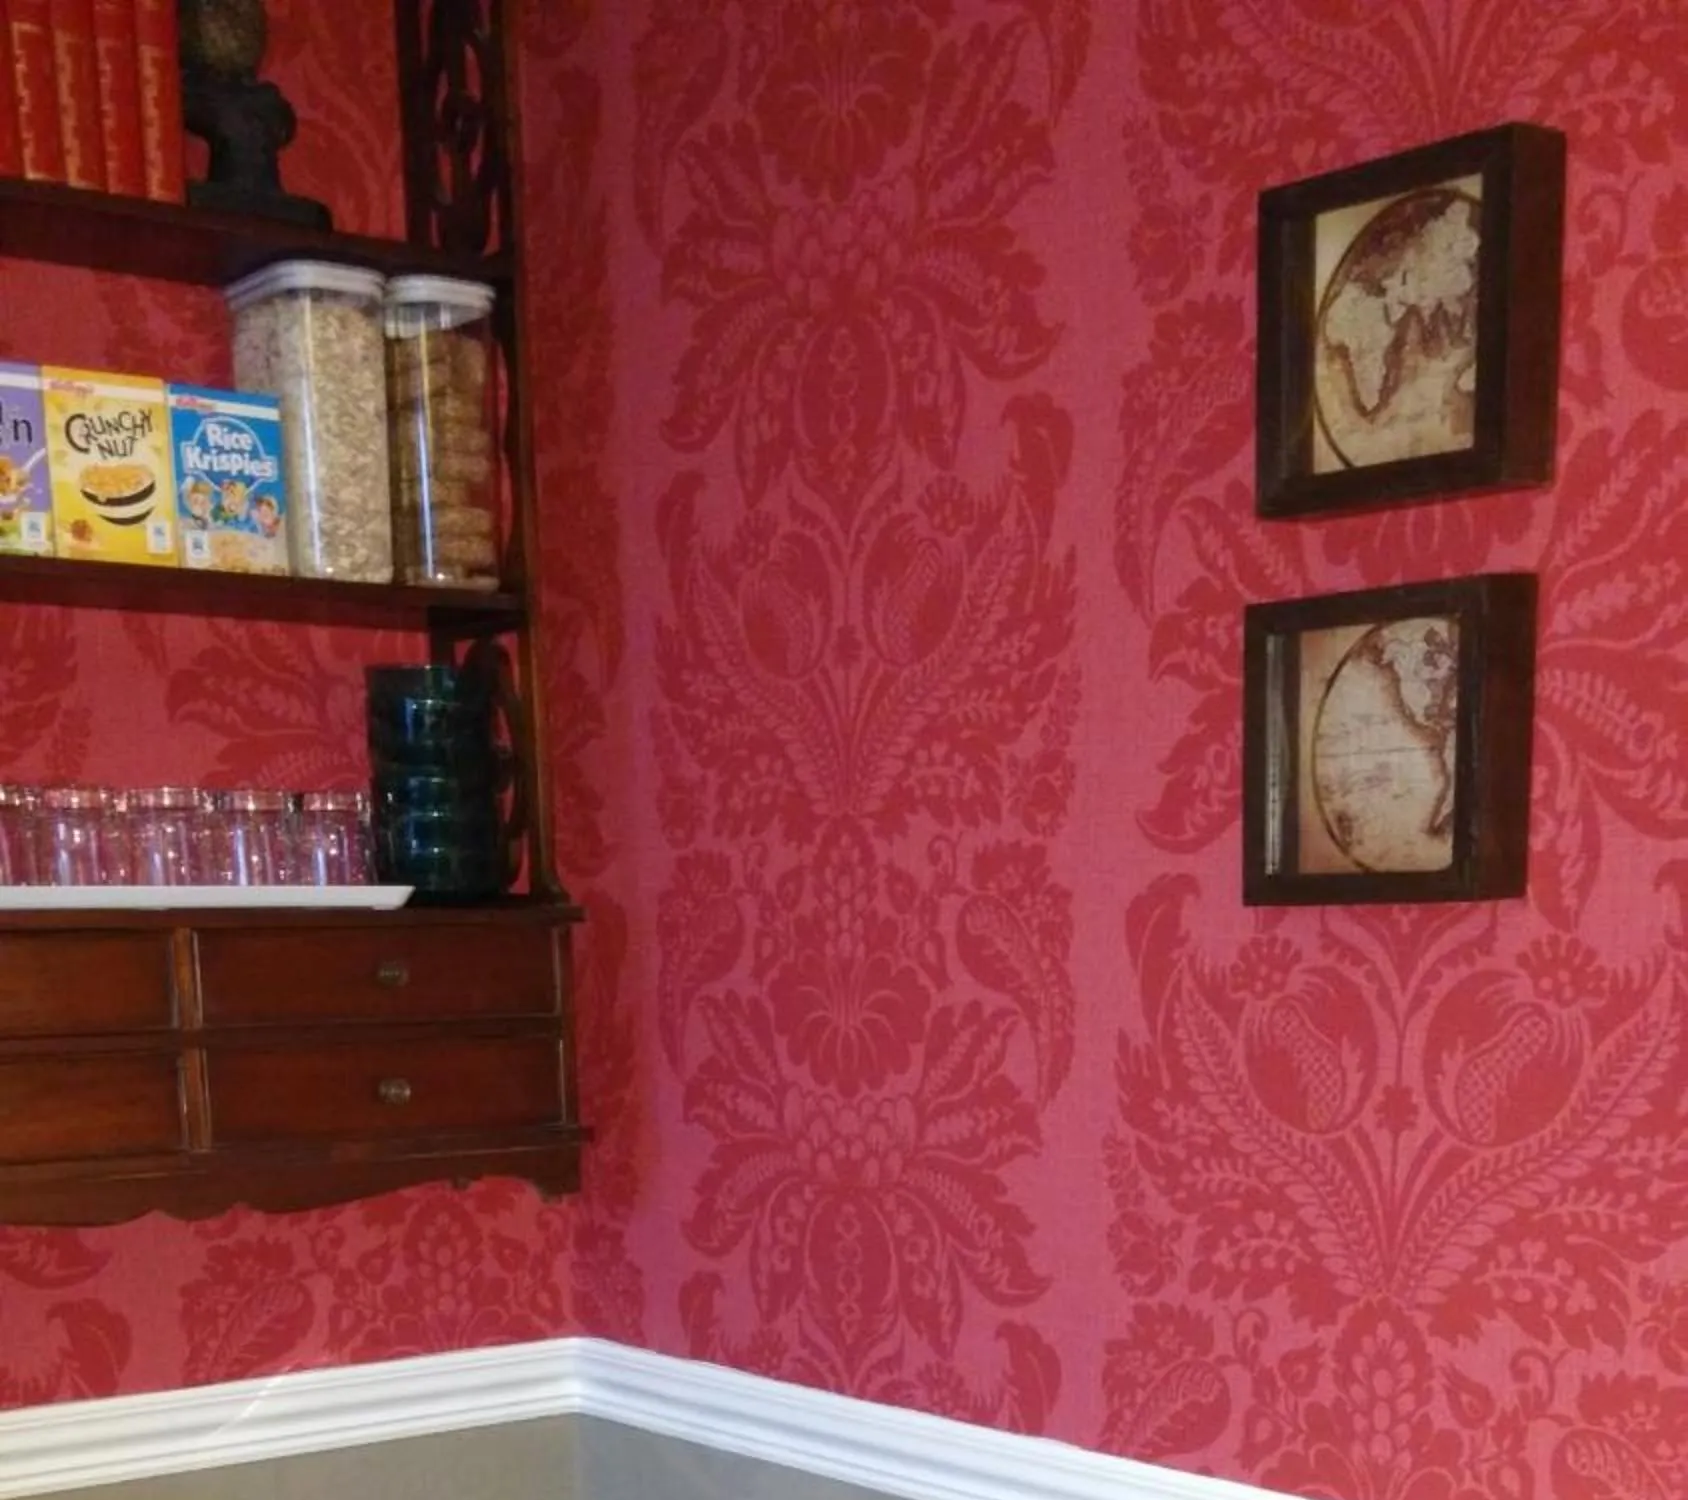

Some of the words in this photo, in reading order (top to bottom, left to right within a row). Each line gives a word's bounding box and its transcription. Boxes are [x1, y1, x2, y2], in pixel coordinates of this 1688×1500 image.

[64, 407, 153, 454] CRUNCHY
[206, 422, 253, 451] Rice
[97, 435, 140, 460] NUT
[184, 445, 274, 477] Krispies
